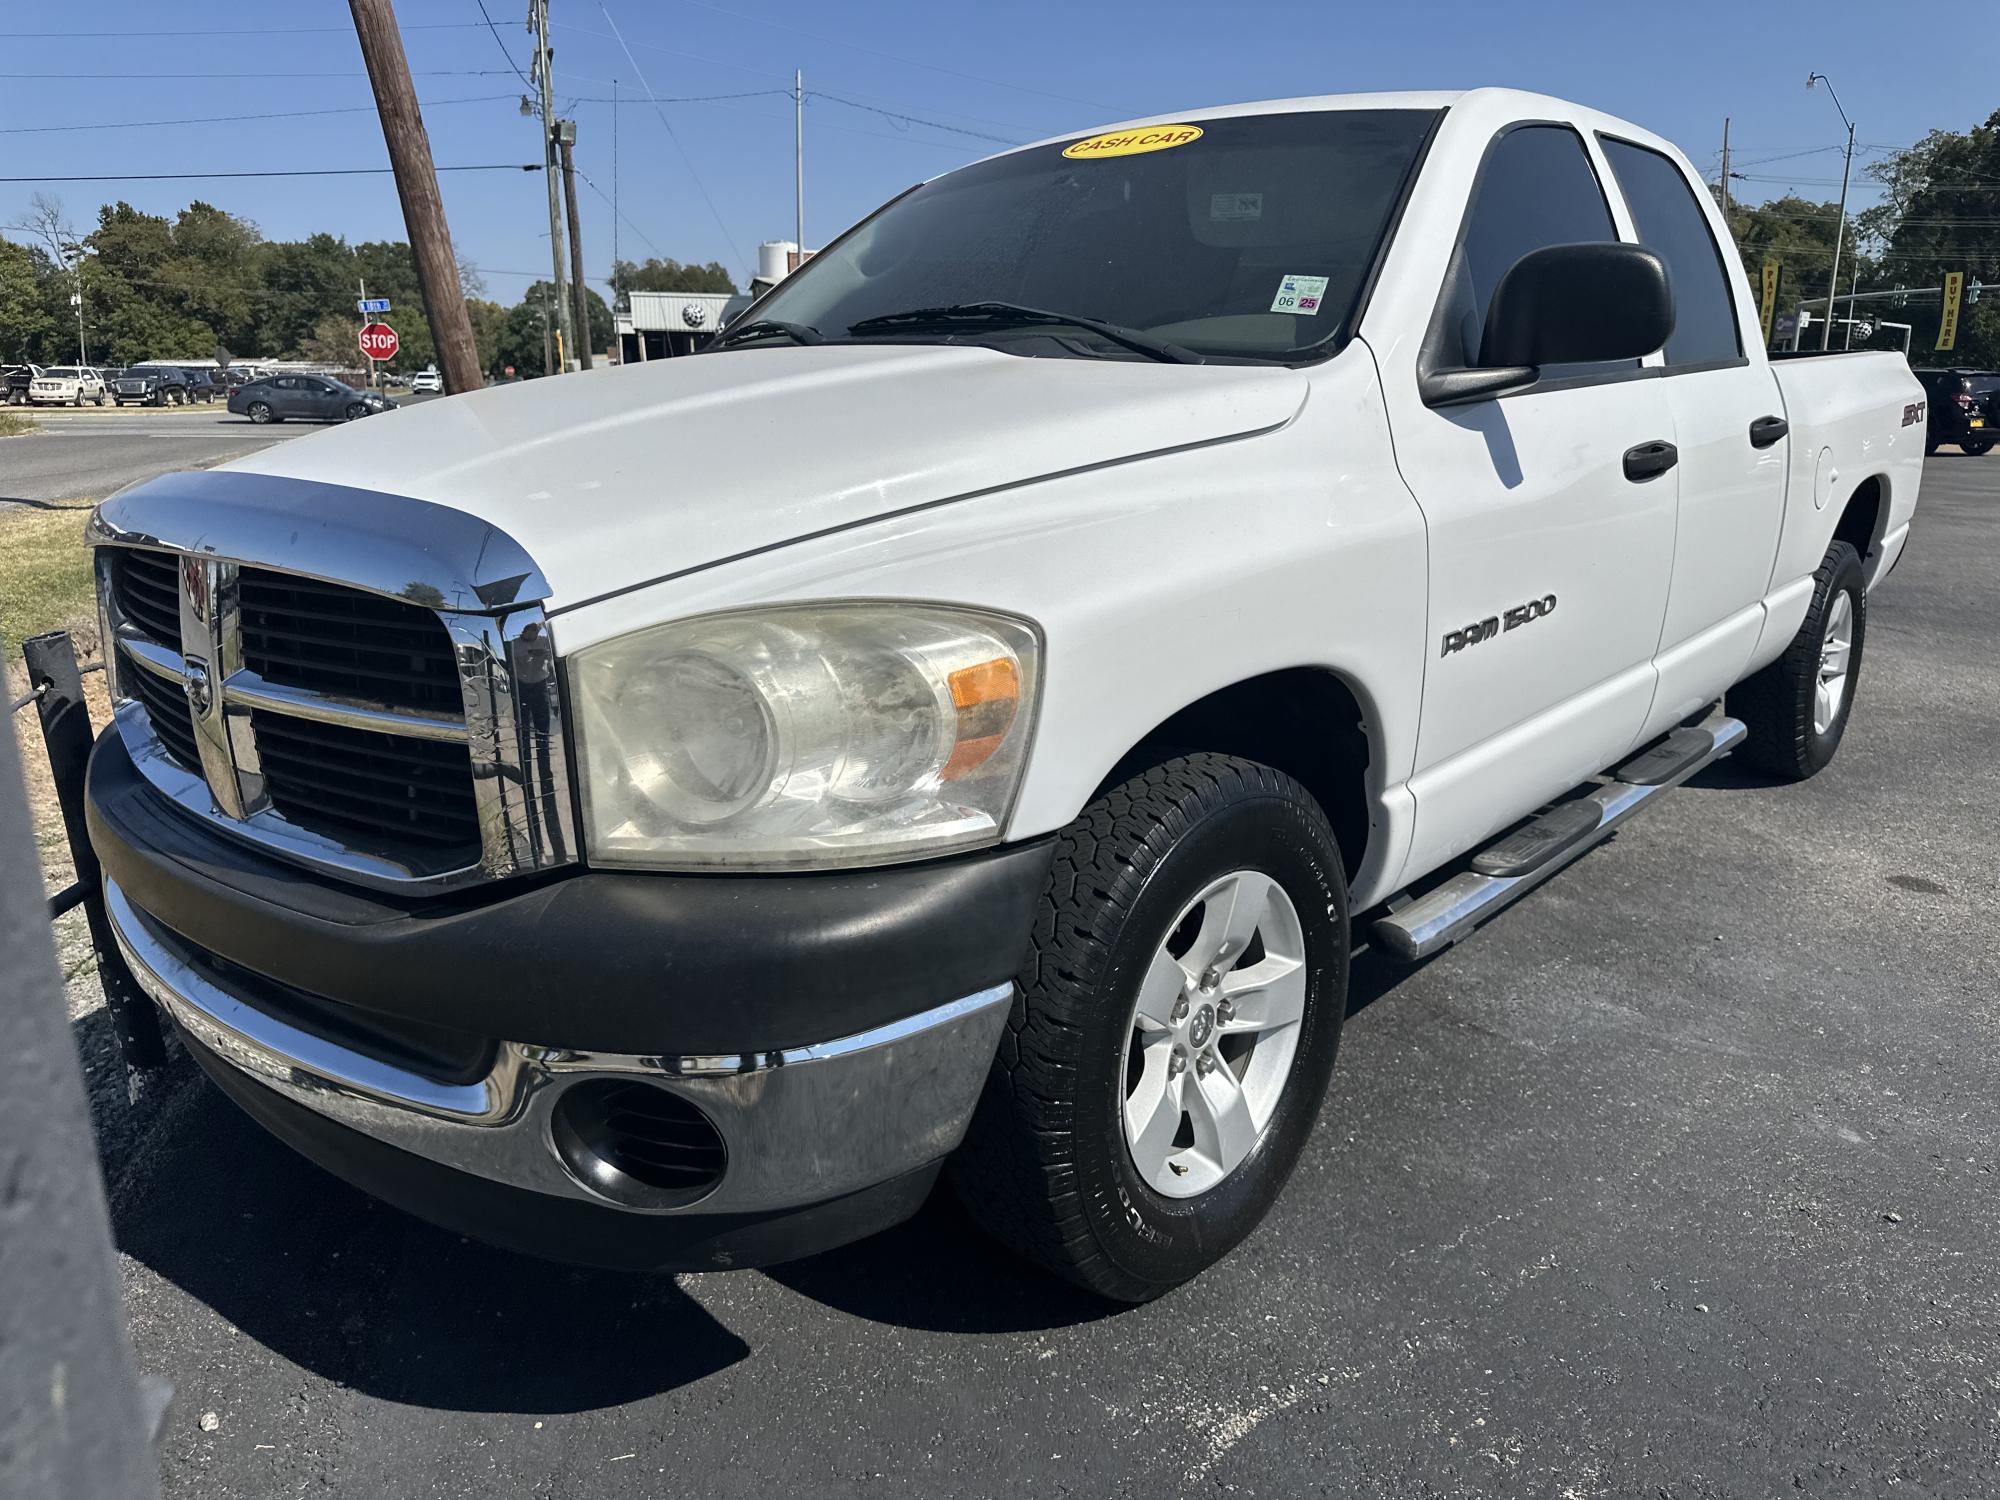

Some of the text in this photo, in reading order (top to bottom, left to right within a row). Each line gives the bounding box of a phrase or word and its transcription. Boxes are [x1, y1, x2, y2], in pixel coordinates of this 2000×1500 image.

[1070, 131, 1195, 153] CASH CAR
[1278, 296, 1317, 309] 06 25
[1941, 276, 1958, 347] BUY HERE
[362, 334, 396, 349] STOP
[1901, 401, 1926, 427] SXT
[1441, 594, 1557, 659] RAM 1500
